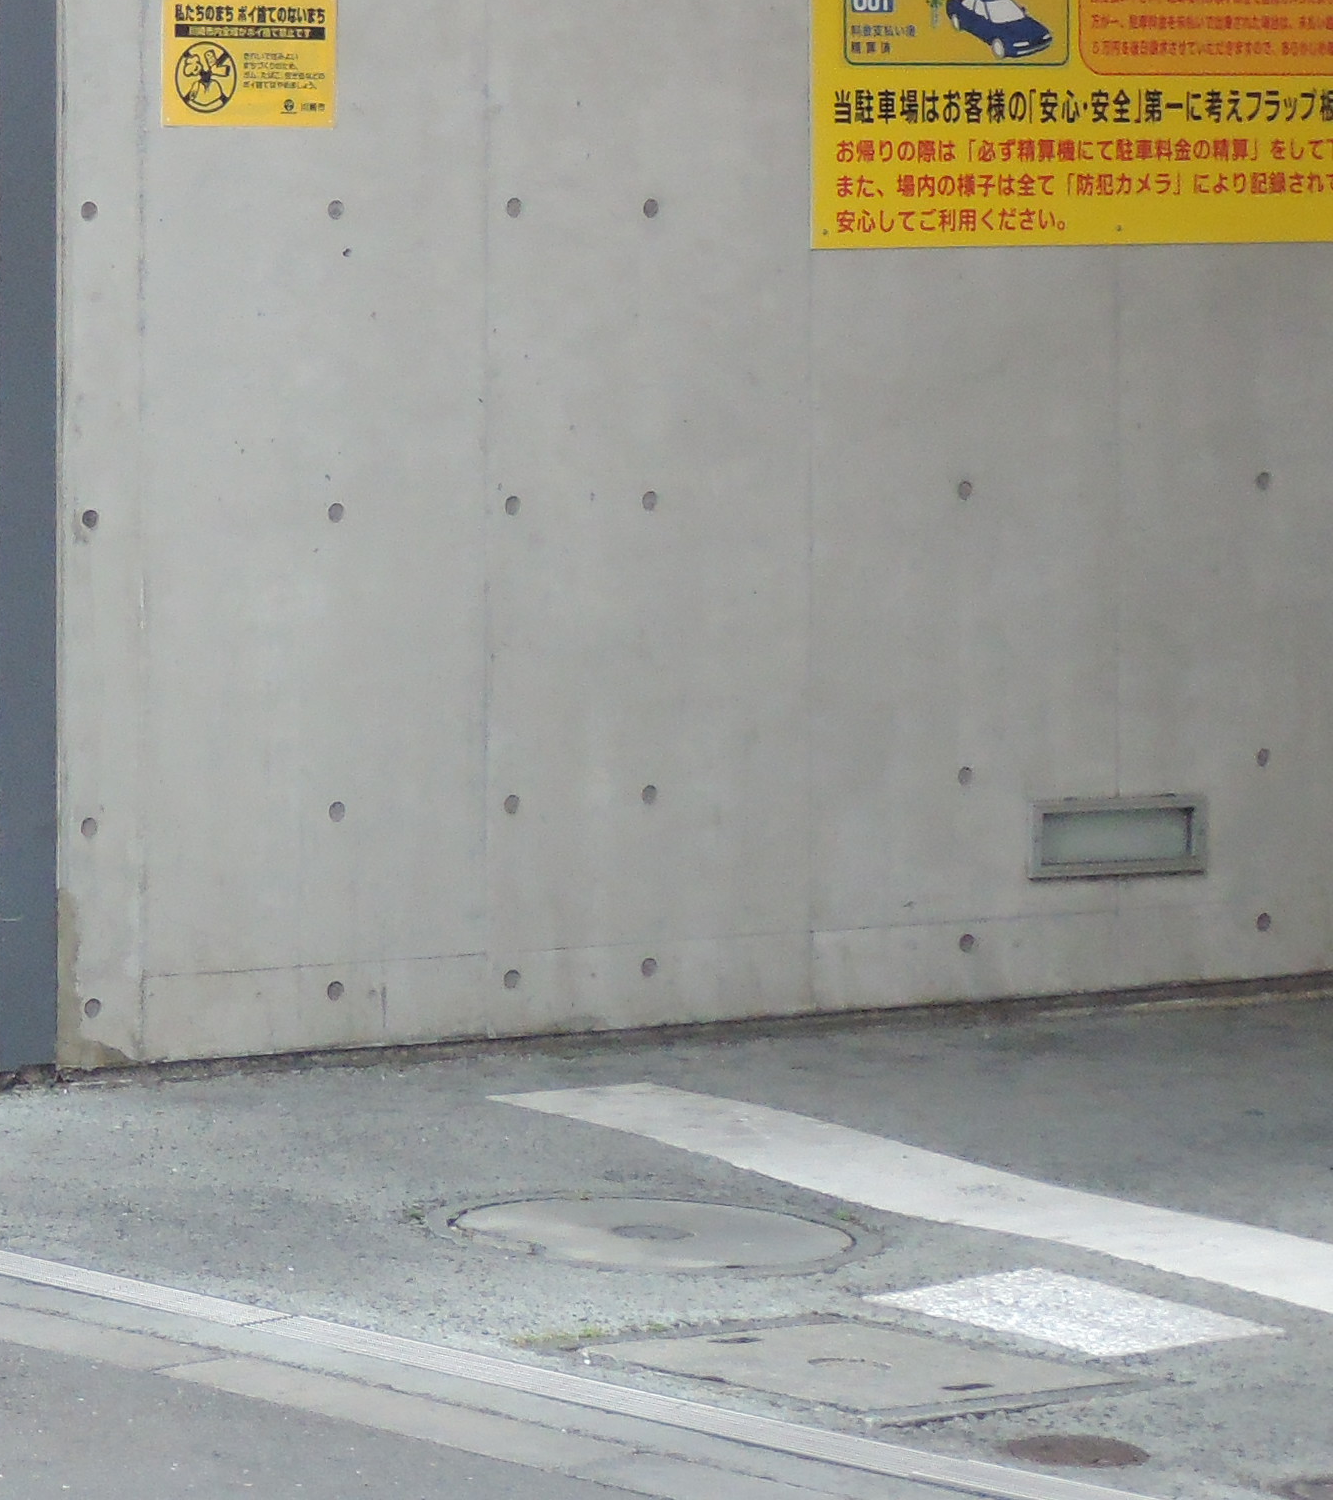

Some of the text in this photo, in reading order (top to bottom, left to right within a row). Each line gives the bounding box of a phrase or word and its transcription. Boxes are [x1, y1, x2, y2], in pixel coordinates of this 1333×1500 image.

[836, 208, 1067, 233] 安心してご利用ください。
